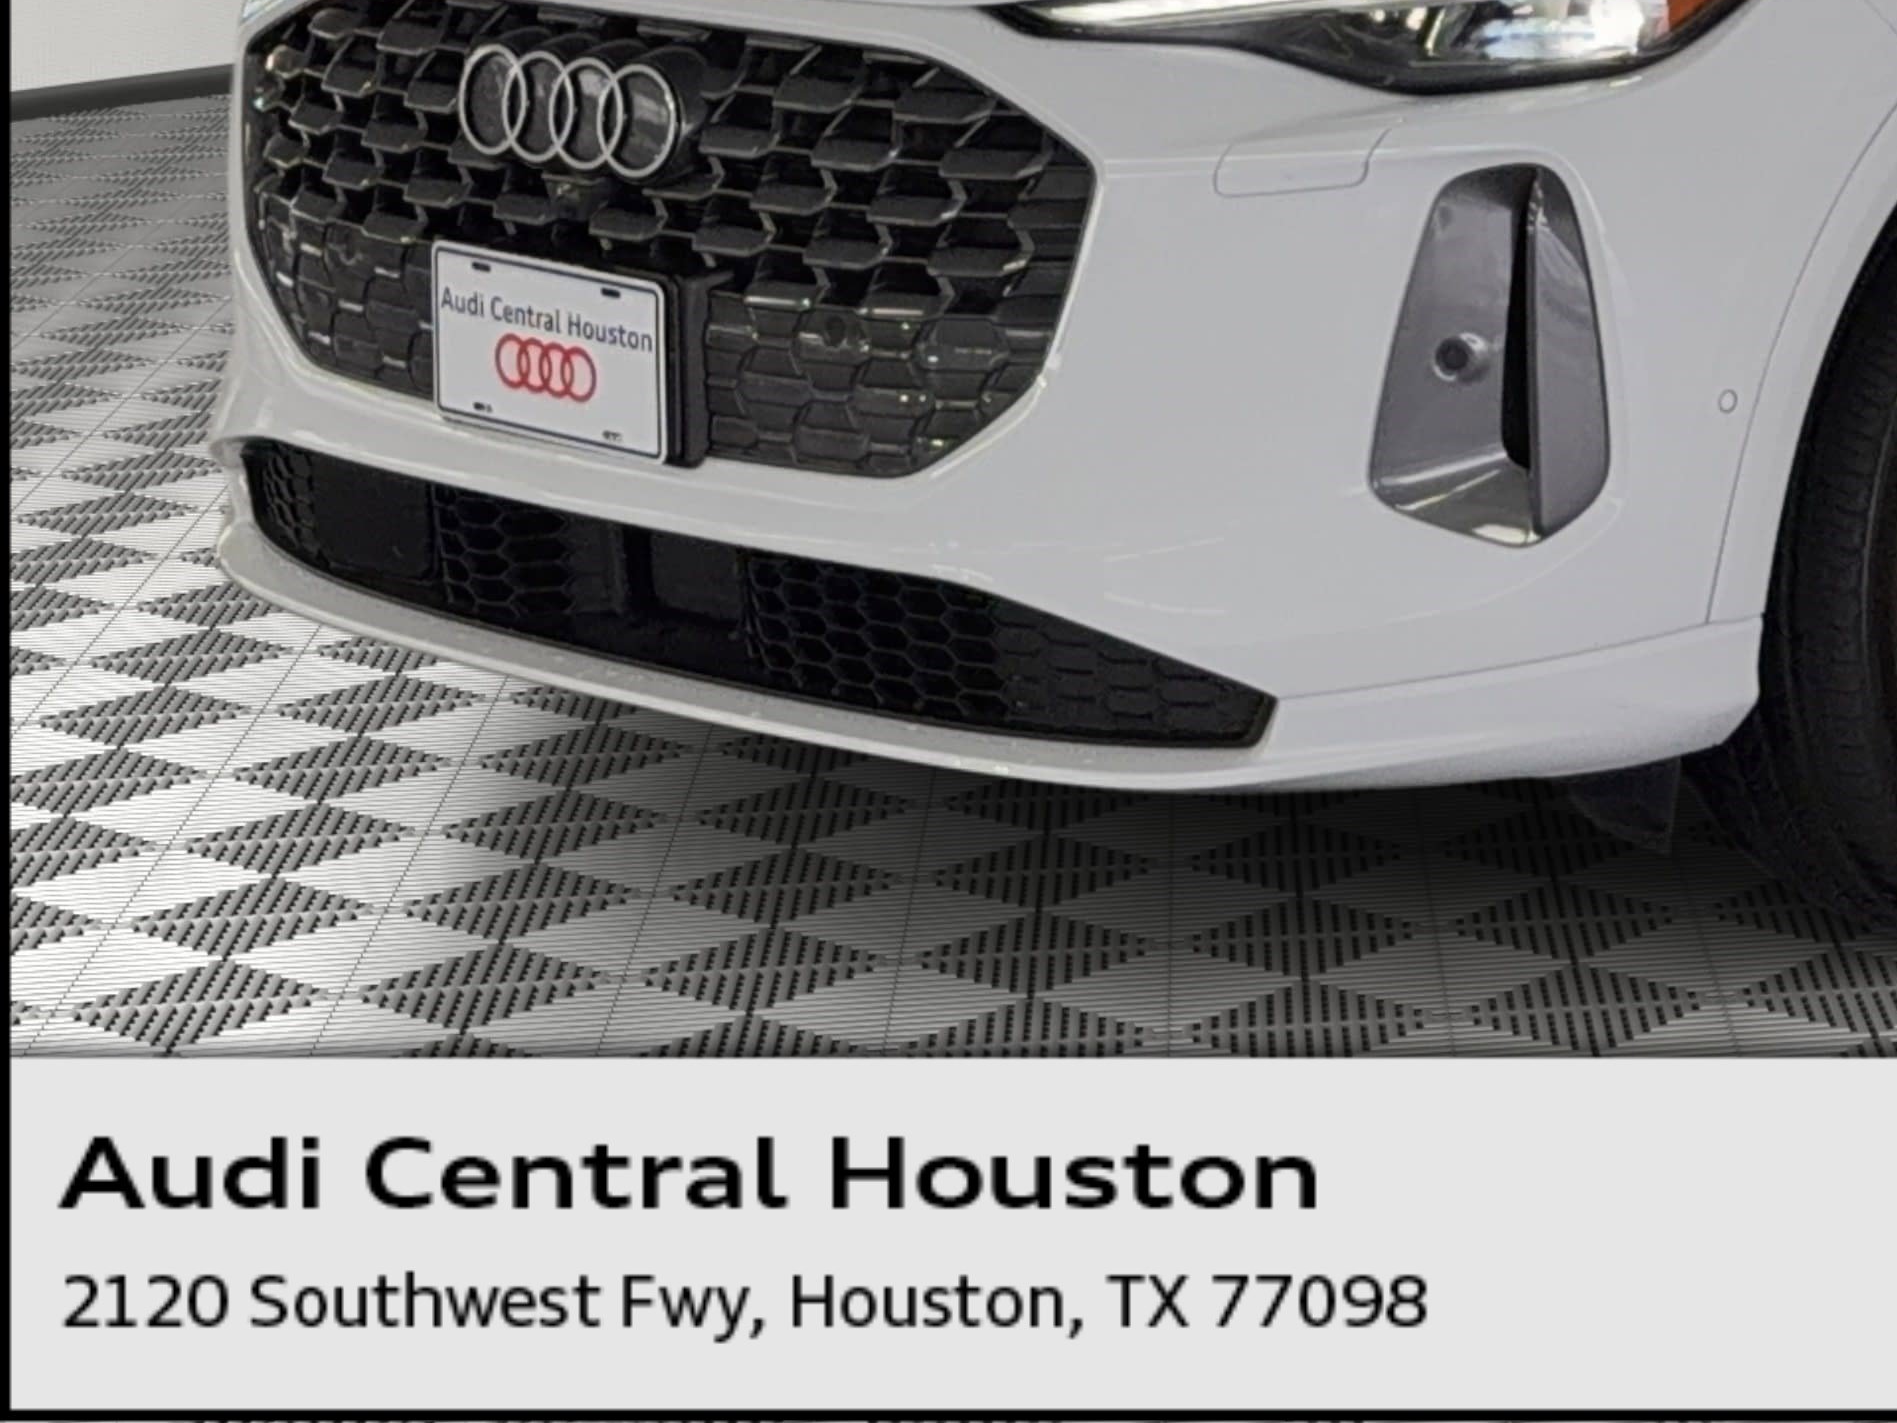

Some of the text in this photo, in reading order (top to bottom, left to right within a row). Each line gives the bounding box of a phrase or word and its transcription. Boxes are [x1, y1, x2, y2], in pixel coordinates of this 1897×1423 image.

[441, 286, 653, 352] Audi Central Houston
